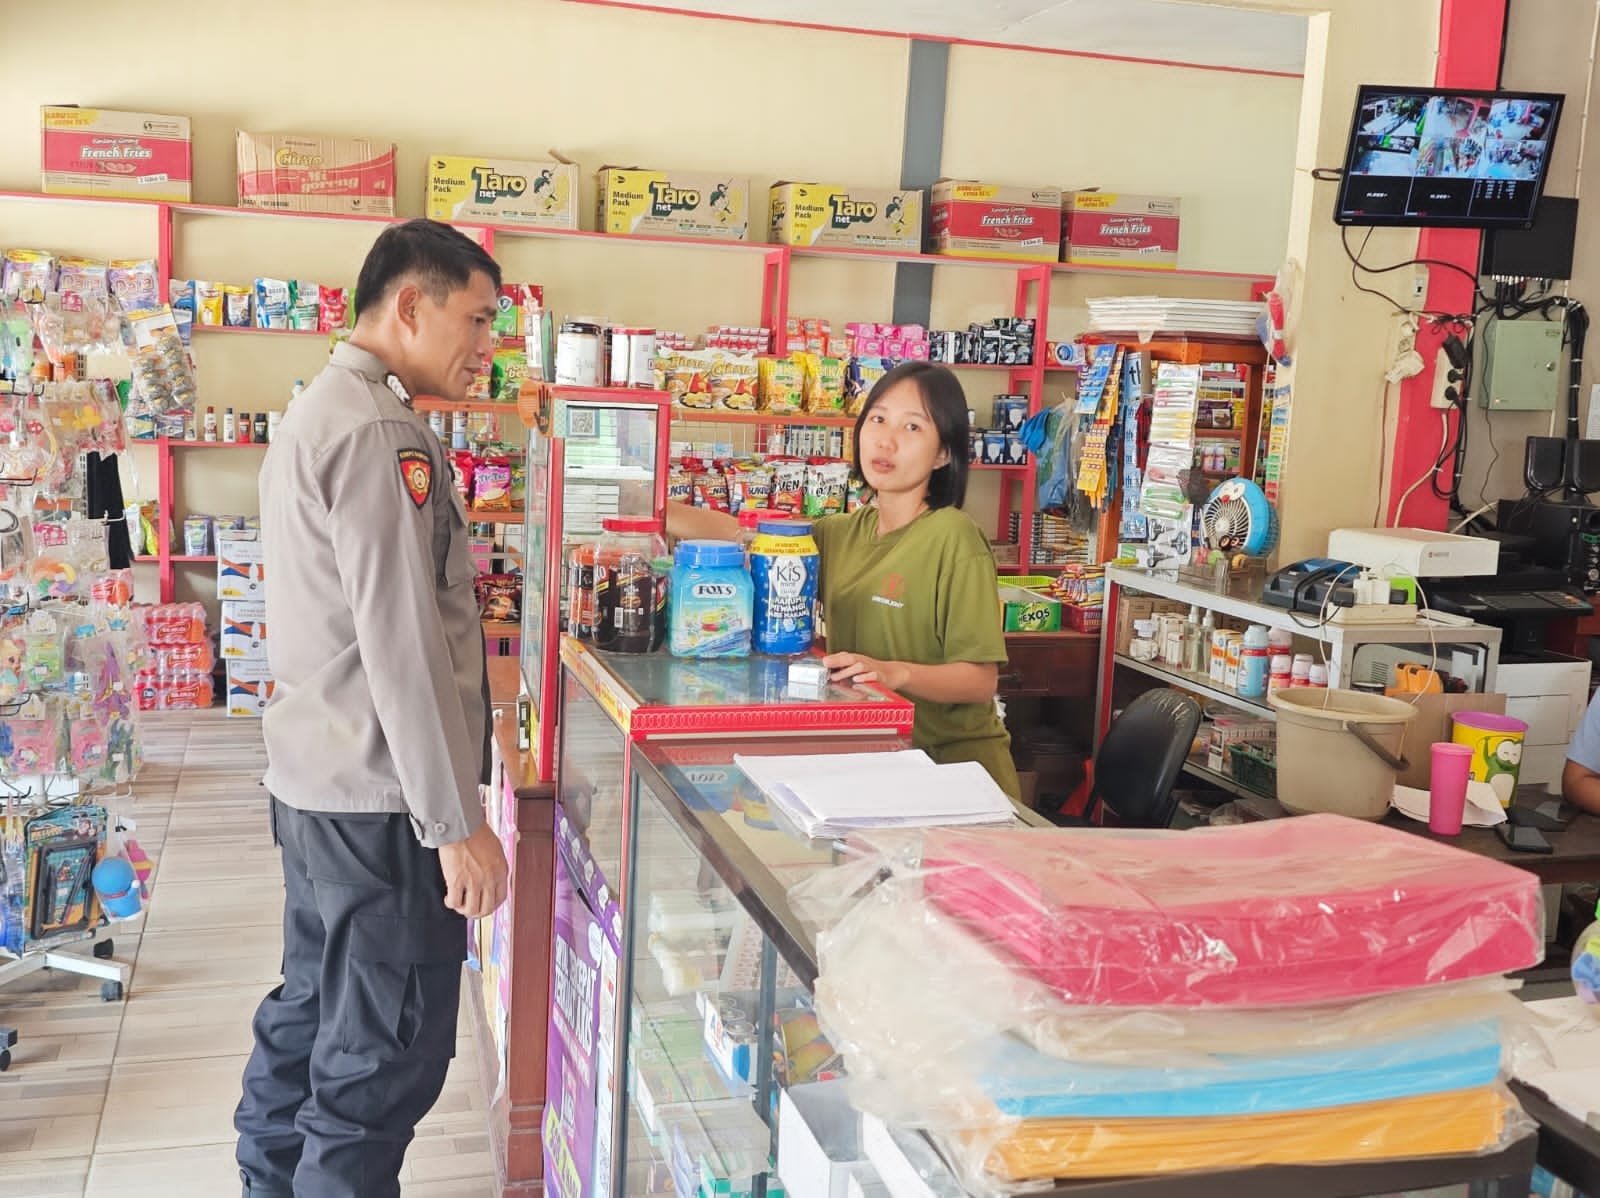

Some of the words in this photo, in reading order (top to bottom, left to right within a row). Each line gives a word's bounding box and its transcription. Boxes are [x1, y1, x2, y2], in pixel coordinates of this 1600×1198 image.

[81, 146, 120, 159] French
[123, 147, 152, 159] Fries
[433, 177, 465, 185] Medium
[473, 167, 527, 194] Taro
[433, 185, 452, 193] Pack
[479, 190, 496, 198] net
[612, 192, 644, 200] Medium
[650, 181, 701, 207] Taro
[656, 203, 672, 211] net
[795, 204, 824, 212] Medium
[829, 195, 877, 219] Taro
[795, 211, 812, 219] Pack
[835, 215, 850, 223] net
[981, 215, 1011, 225] French
[1013, 215, 1033, 225] Fries
[1100, 223, 1129, 234] French
[1131, 224, 1152, 234] Fries
